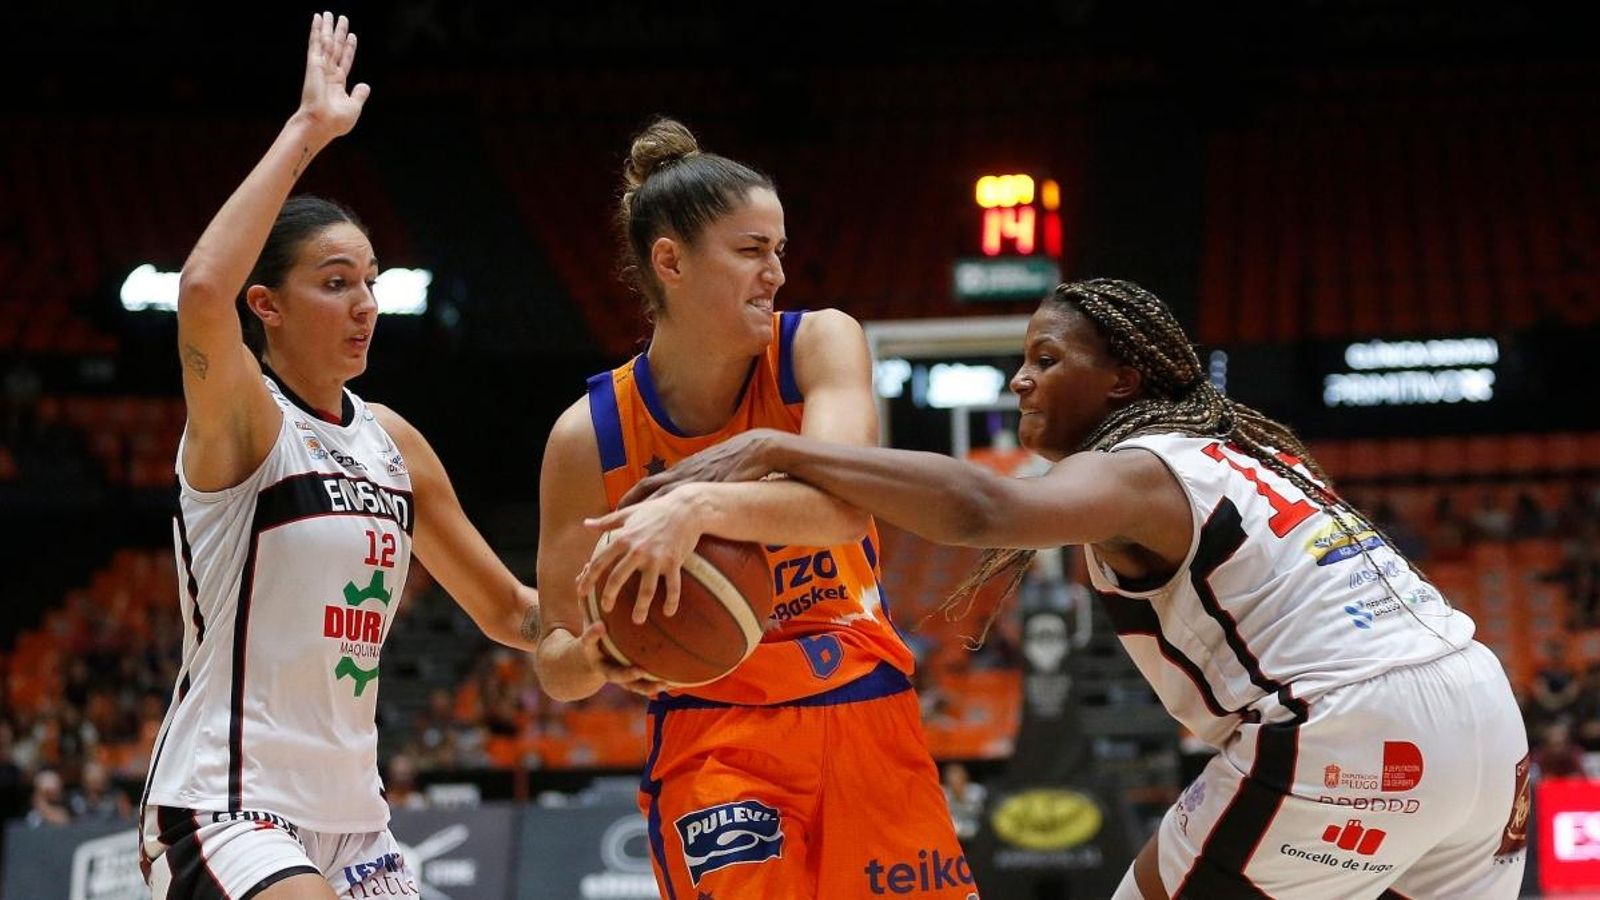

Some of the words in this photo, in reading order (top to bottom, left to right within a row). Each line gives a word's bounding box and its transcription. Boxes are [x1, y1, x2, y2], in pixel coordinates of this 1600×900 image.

[981, 206, 1036, 256] 14
[364, 530, 396, 568] 12
[774, 550, 838, 596] rzo
[770, 584, 848, 620] Basket
[323, 605, 387, 644] DUR
[1349, 780, 1378, 790] LUGO
[1280, 844, 1338, 867] Concello
[1341, 859, 1360, 871] de
